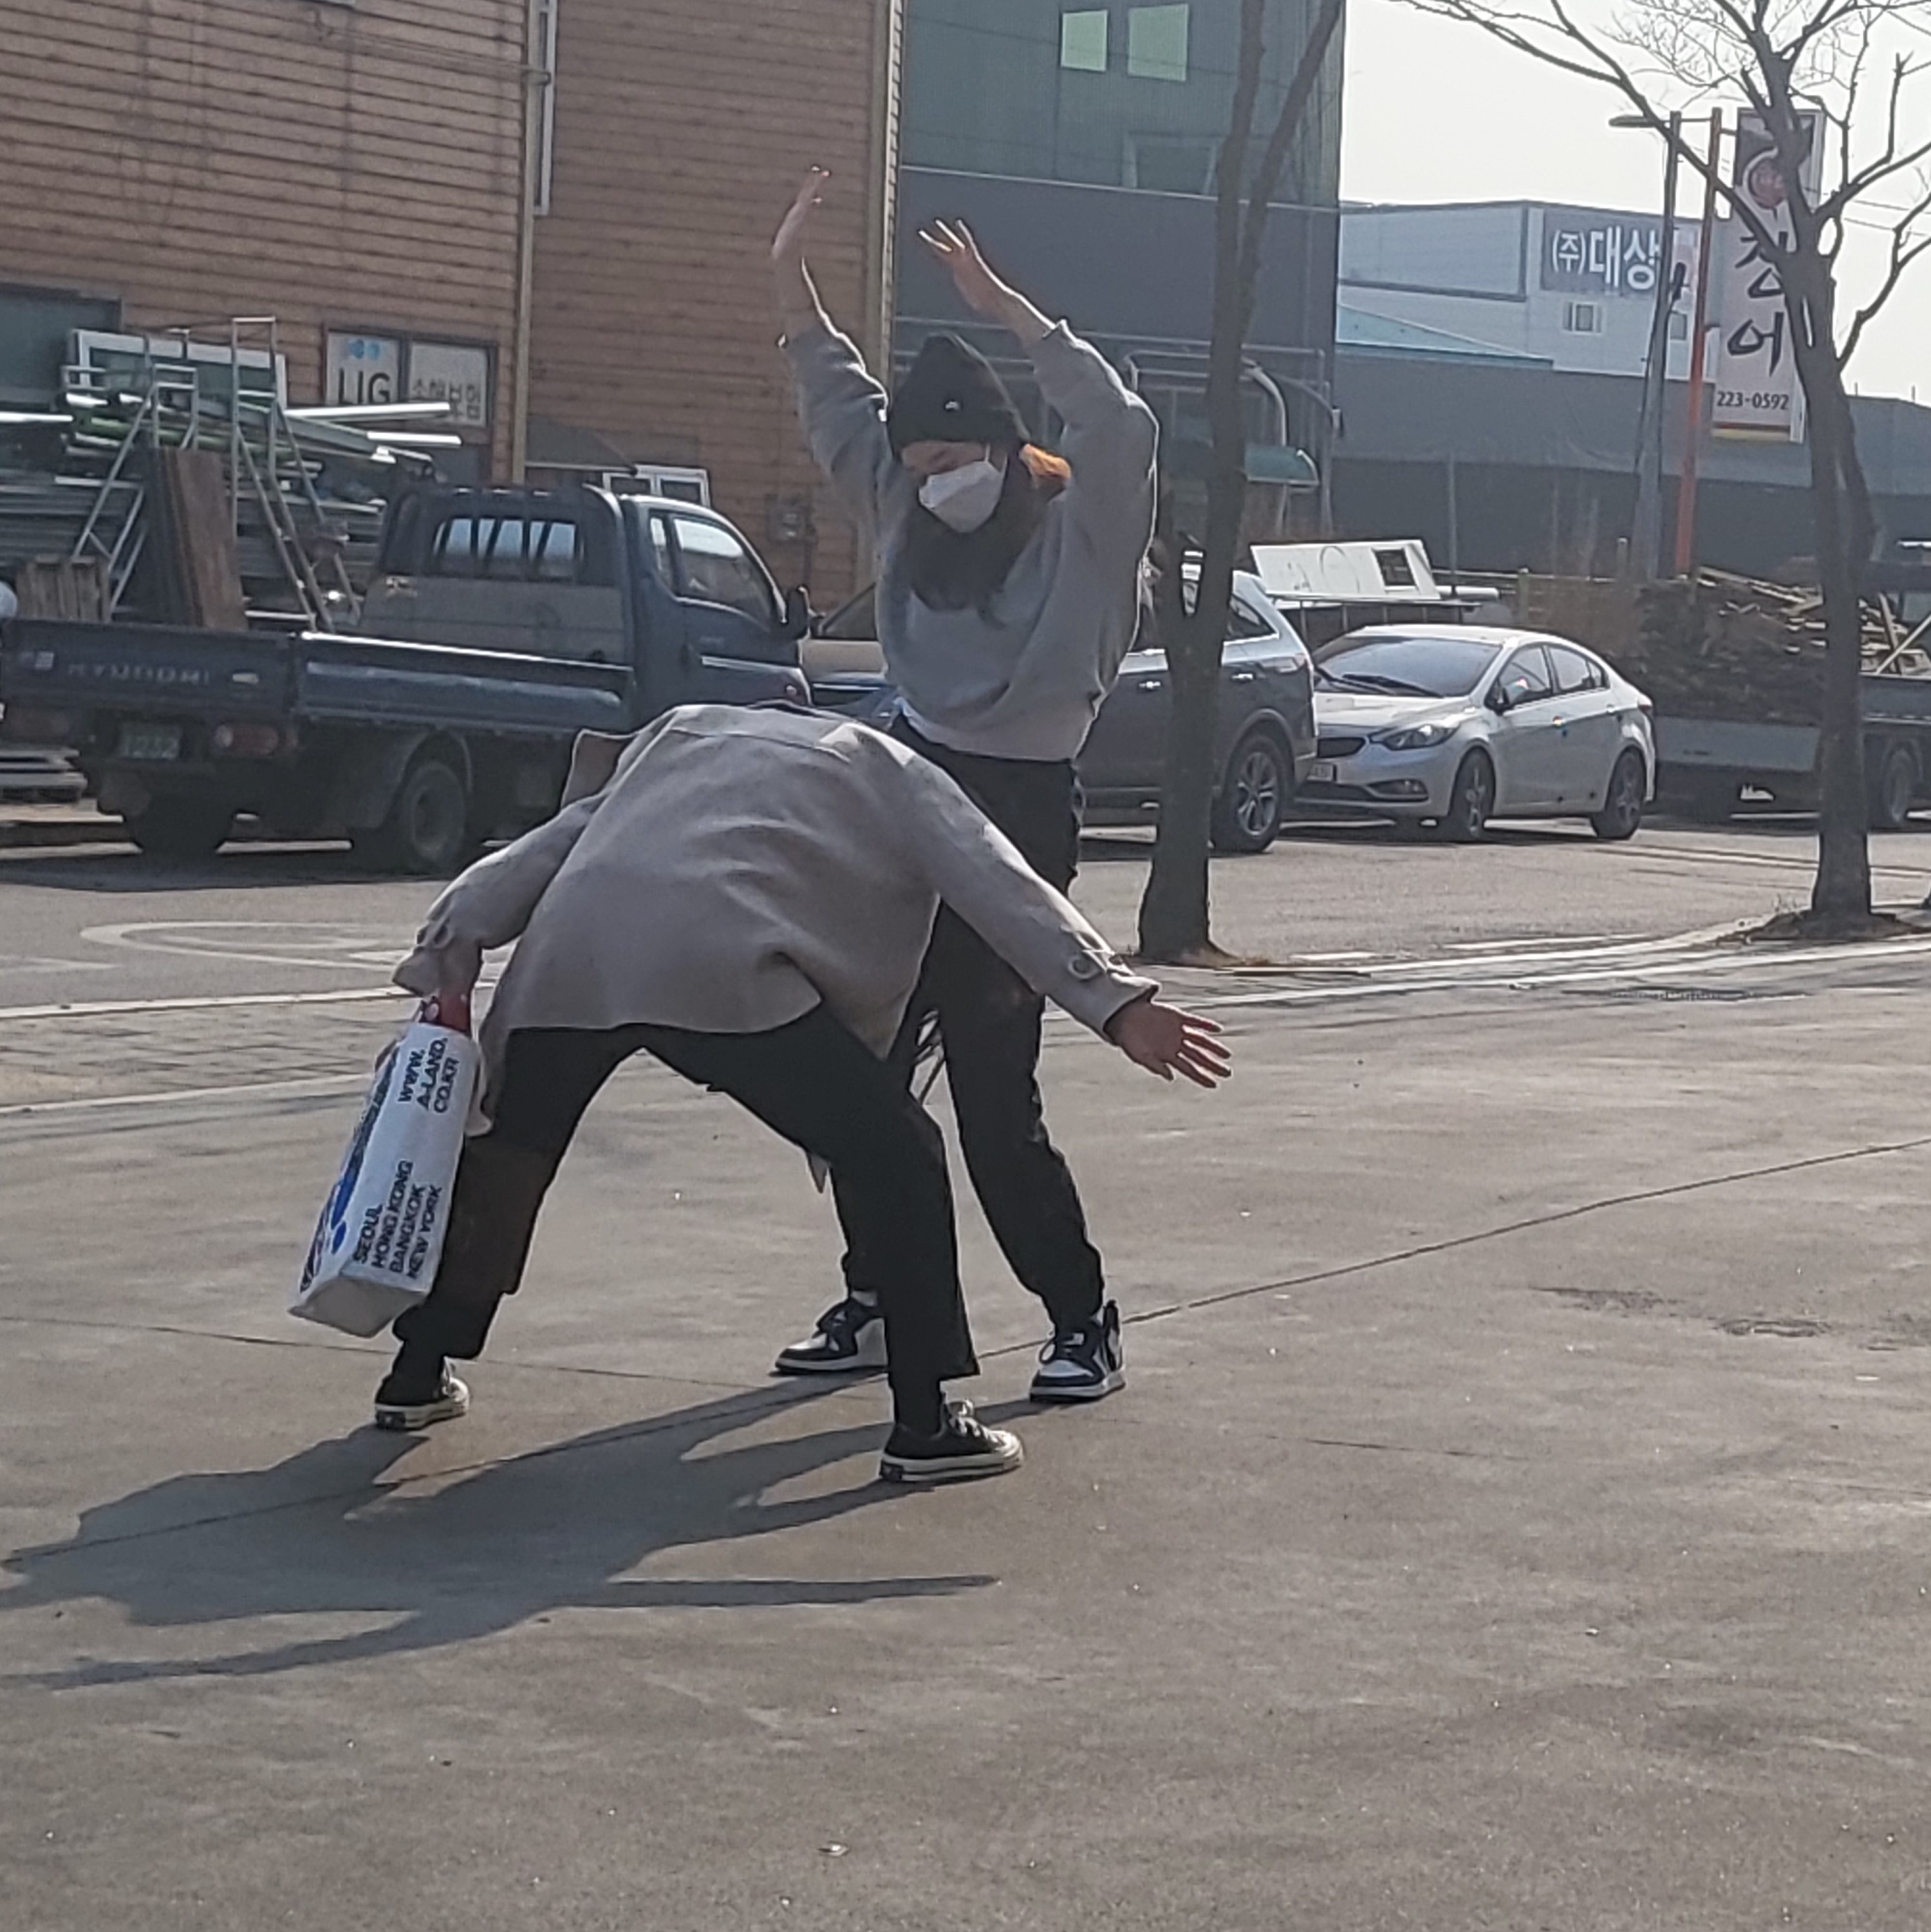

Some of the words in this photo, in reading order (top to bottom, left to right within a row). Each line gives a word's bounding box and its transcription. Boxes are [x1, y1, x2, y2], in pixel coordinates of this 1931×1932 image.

[1553, 225, 1661, 290] (주)대상
[1717, 390, 1789, 411] 223-0592
[353, 1204, 383, 1264] SEOUL
[371, 1214, 398, 1268] HONG
[387, 1160, 413, 1213] KONG
[389, 1183, 425, 1273] BANGKOK
[406, 1237, 429, 1279] NEW
[419, 1185, 443, 1232] YORK
